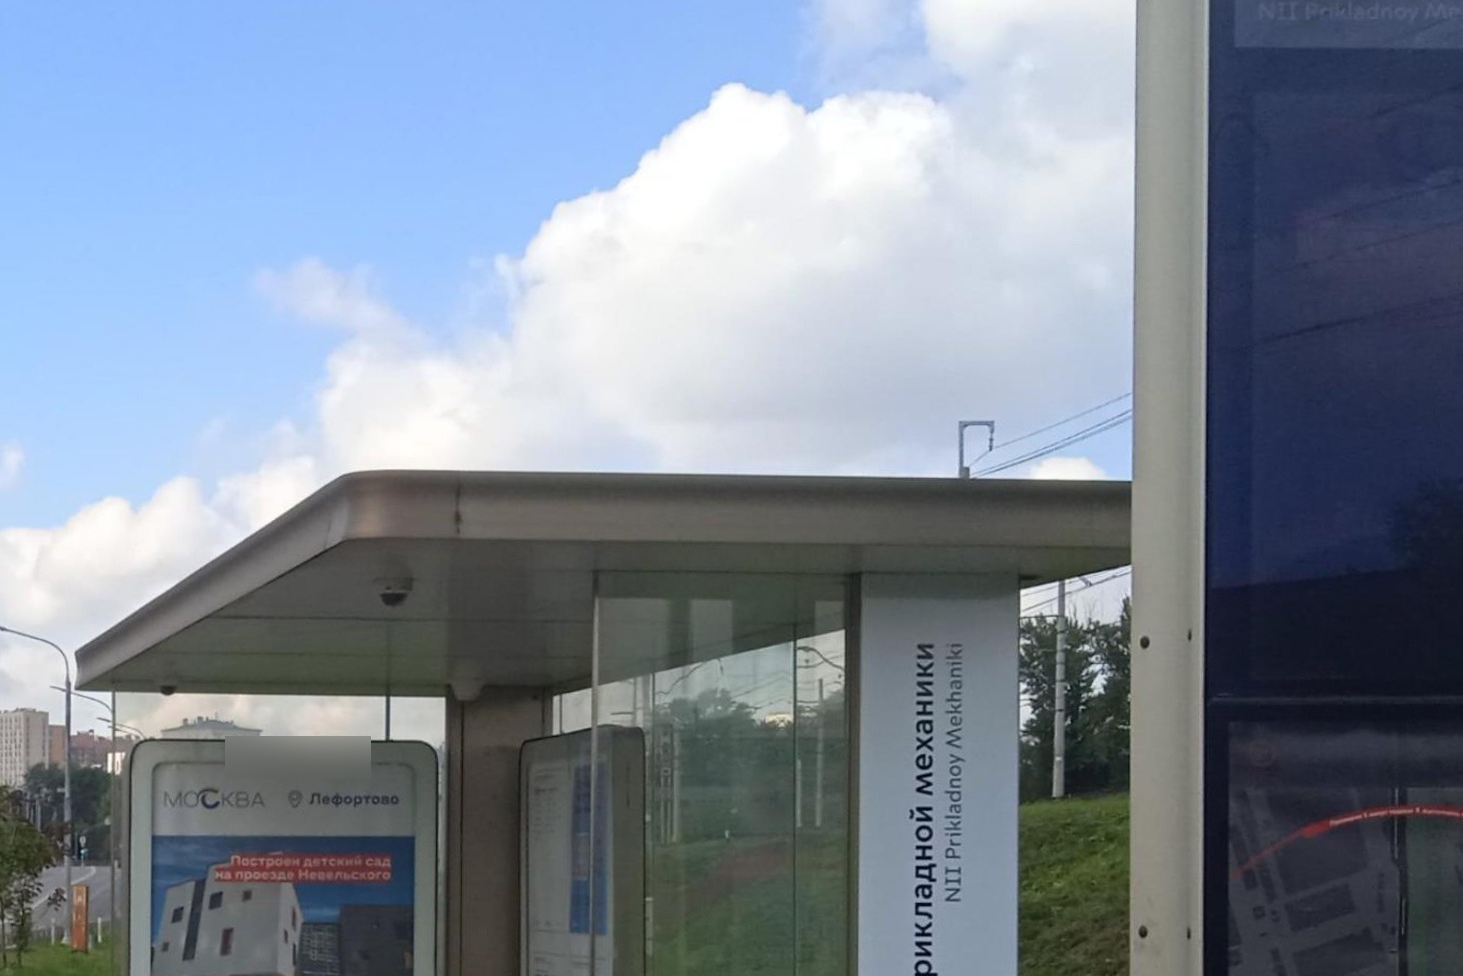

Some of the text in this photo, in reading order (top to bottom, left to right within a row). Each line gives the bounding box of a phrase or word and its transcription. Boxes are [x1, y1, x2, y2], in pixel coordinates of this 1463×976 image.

[915, 644, 934, 796] механики
[945, 643, 966, 902] NII Prikladnoy Mekhaniki
[163, 788, 265, 809] МОСКВА
[309, 792, 399, 806] Лефортово
[230, 855, 391, 869] Построен детский сад
[215, 869, 391, 882] на проезде Невельского
